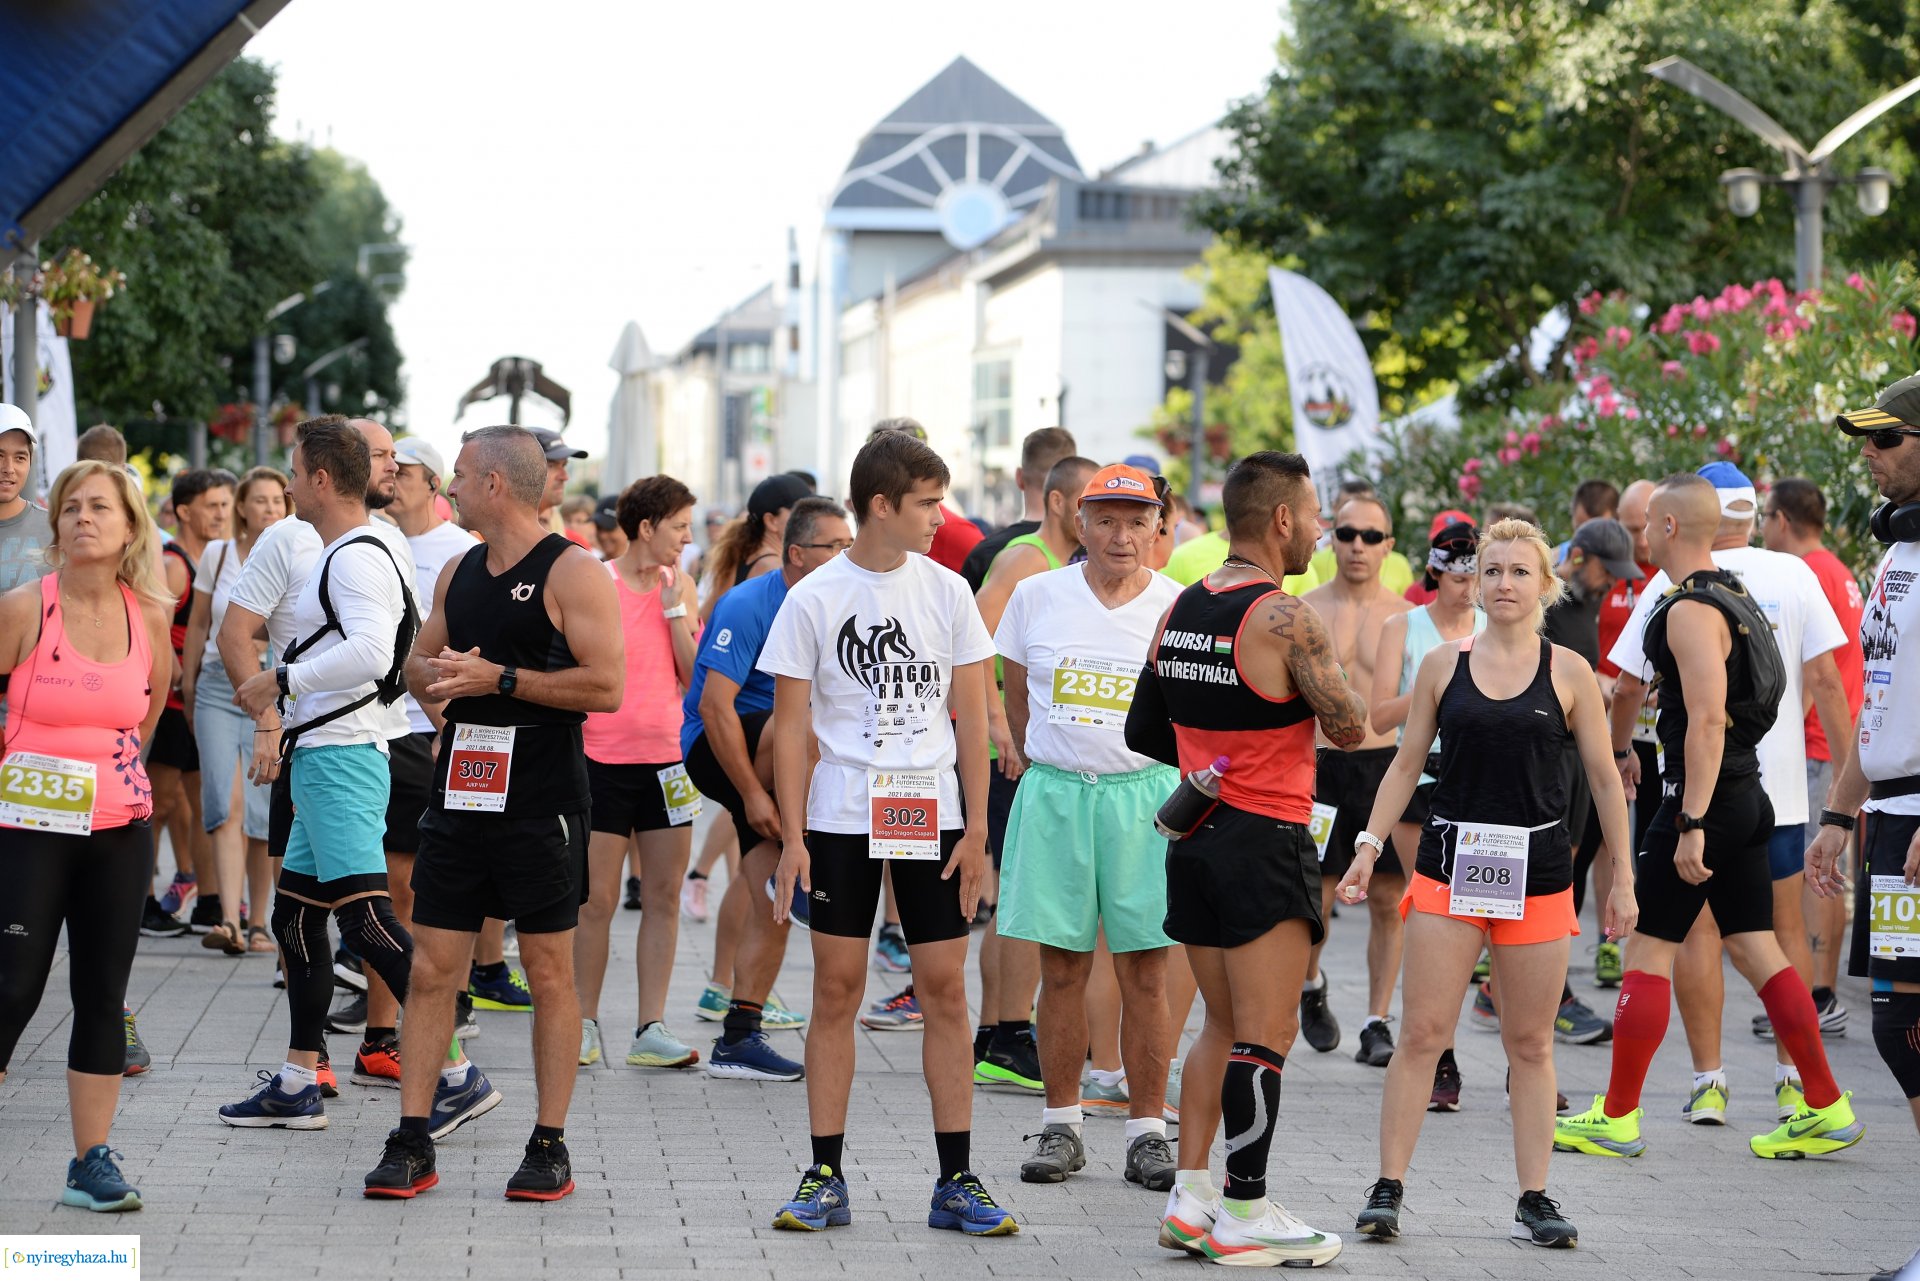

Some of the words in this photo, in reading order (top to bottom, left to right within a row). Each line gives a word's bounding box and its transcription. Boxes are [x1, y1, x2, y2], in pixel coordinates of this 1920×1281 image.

[1885, 582, 1910, 594] TRAIL
[1160, 630, 1213, 652] MURSA
[35, 675, 74, 687] Rotary
[873, 665, 940, 684] DRAGON
[1157, 656, 1238, 685] NYÍREGYHÁZA
[1060, 672, 1136, 702] 2352
[459, 760, 498, 779] 307
[6, 768, 84, 801] 2335
[883, 806, 927, 827] 302
[1465, 865, 1512, 886] 208
